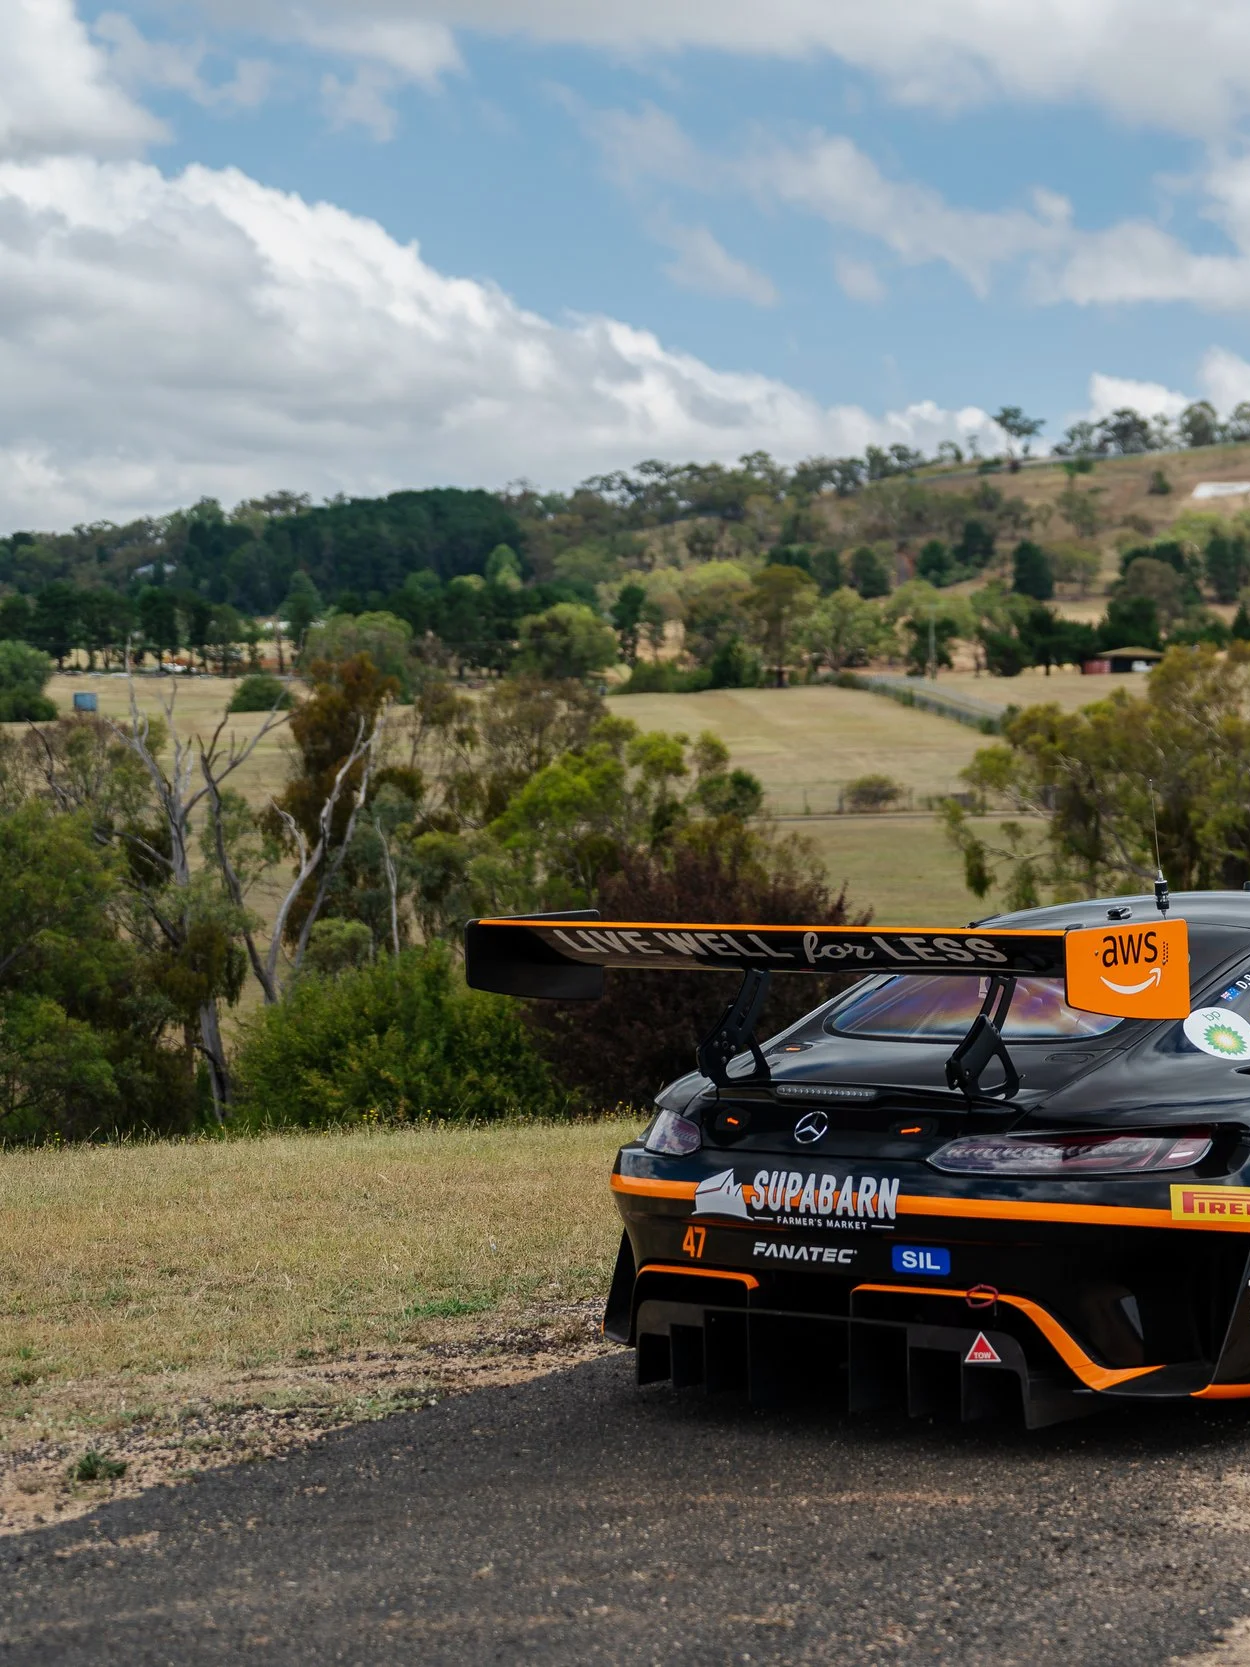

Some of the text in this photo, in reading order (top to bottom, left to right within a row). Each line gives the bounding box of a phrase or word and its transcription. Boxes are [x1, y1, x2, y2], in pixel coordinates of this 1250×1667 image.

[553, 929, 1008, 964] LIVE WELL for LESS
[1102, 931, 1158, 967] aws
[1235, 980, 1250, 990] D.
[1201, 1009, 1221, 1023] bp
[751, 1169, 900, 1219] SUPABARN
[777, 1215, 867, 1230] FARMER'S MARKET
[682, 1225, 706, 1258] 47
[753, 1241, 857, 1264] FANATEC
[902, 1250, 941, 1270] SIL
[973, 1351, 992, 1359] TOW
